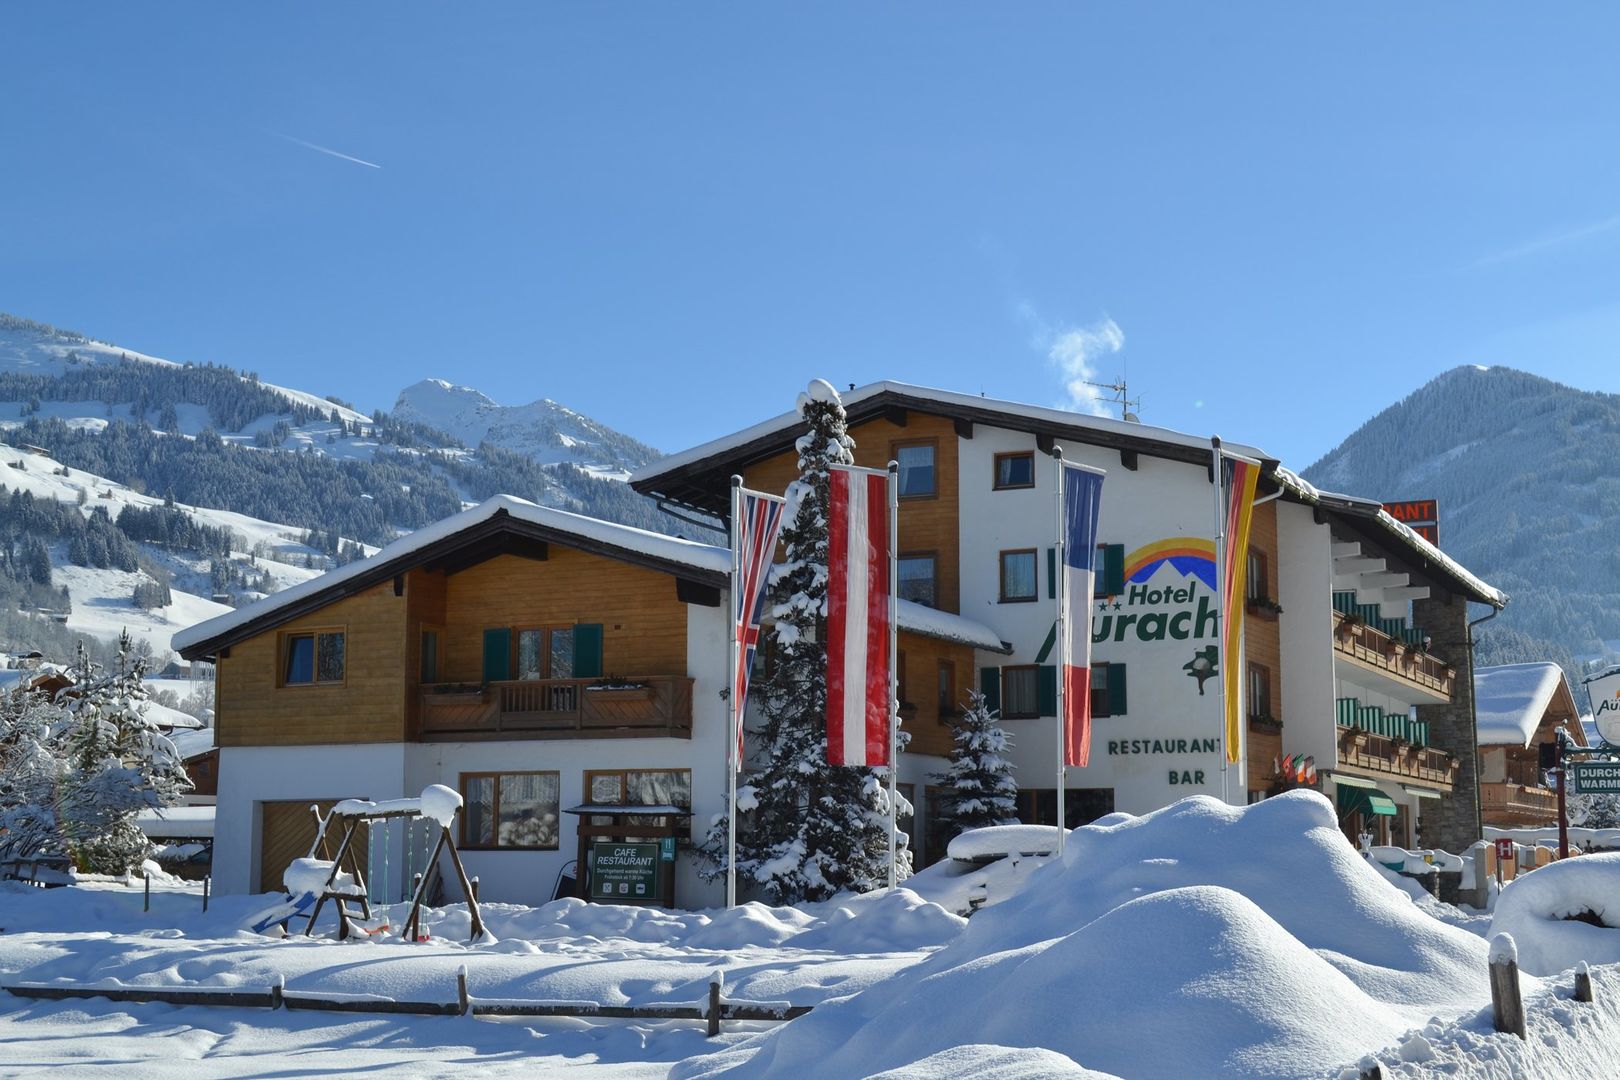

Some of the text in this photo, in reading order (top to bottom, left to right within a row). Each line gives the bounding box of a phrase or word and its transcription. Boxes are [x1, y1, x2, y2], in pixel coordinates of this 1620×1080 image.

[1128, 581, 1196, 606] Hotel
[1168, 770, 1205, 785] BAR
[1580, 768, 1620, 778] DURCH
[614, 848, 637, 857] CAFE
[597, 856, 653, 866] RESTAURANT
